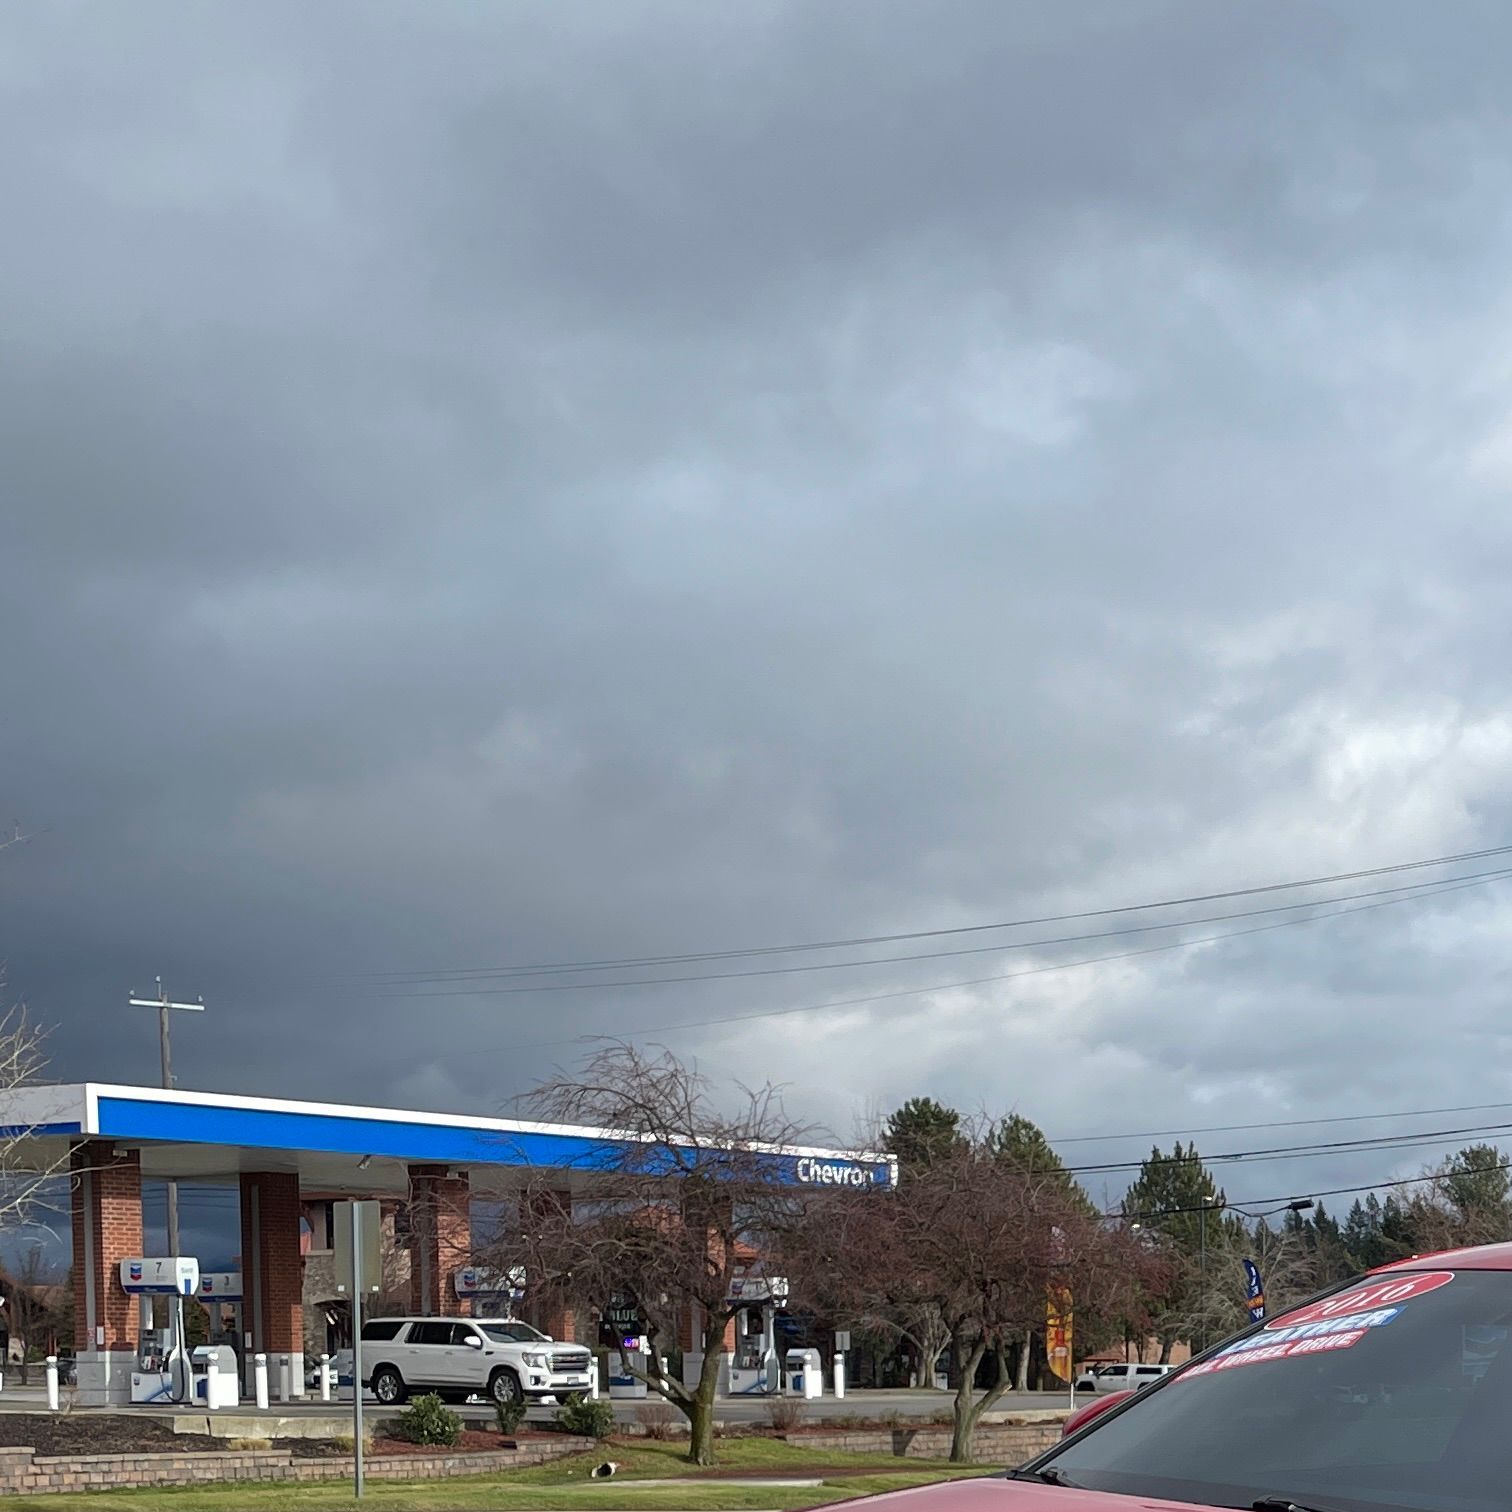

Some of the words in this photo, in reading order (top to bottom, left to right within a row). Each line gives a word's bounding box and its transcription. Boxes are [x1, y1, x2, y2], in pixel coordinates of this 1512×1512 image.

[797, 1158, 874, 1185] Chevron
[1217, 1343, 1293, 1369] WHEEL
[1287, 1330, 1365, 1355] DRIVE
